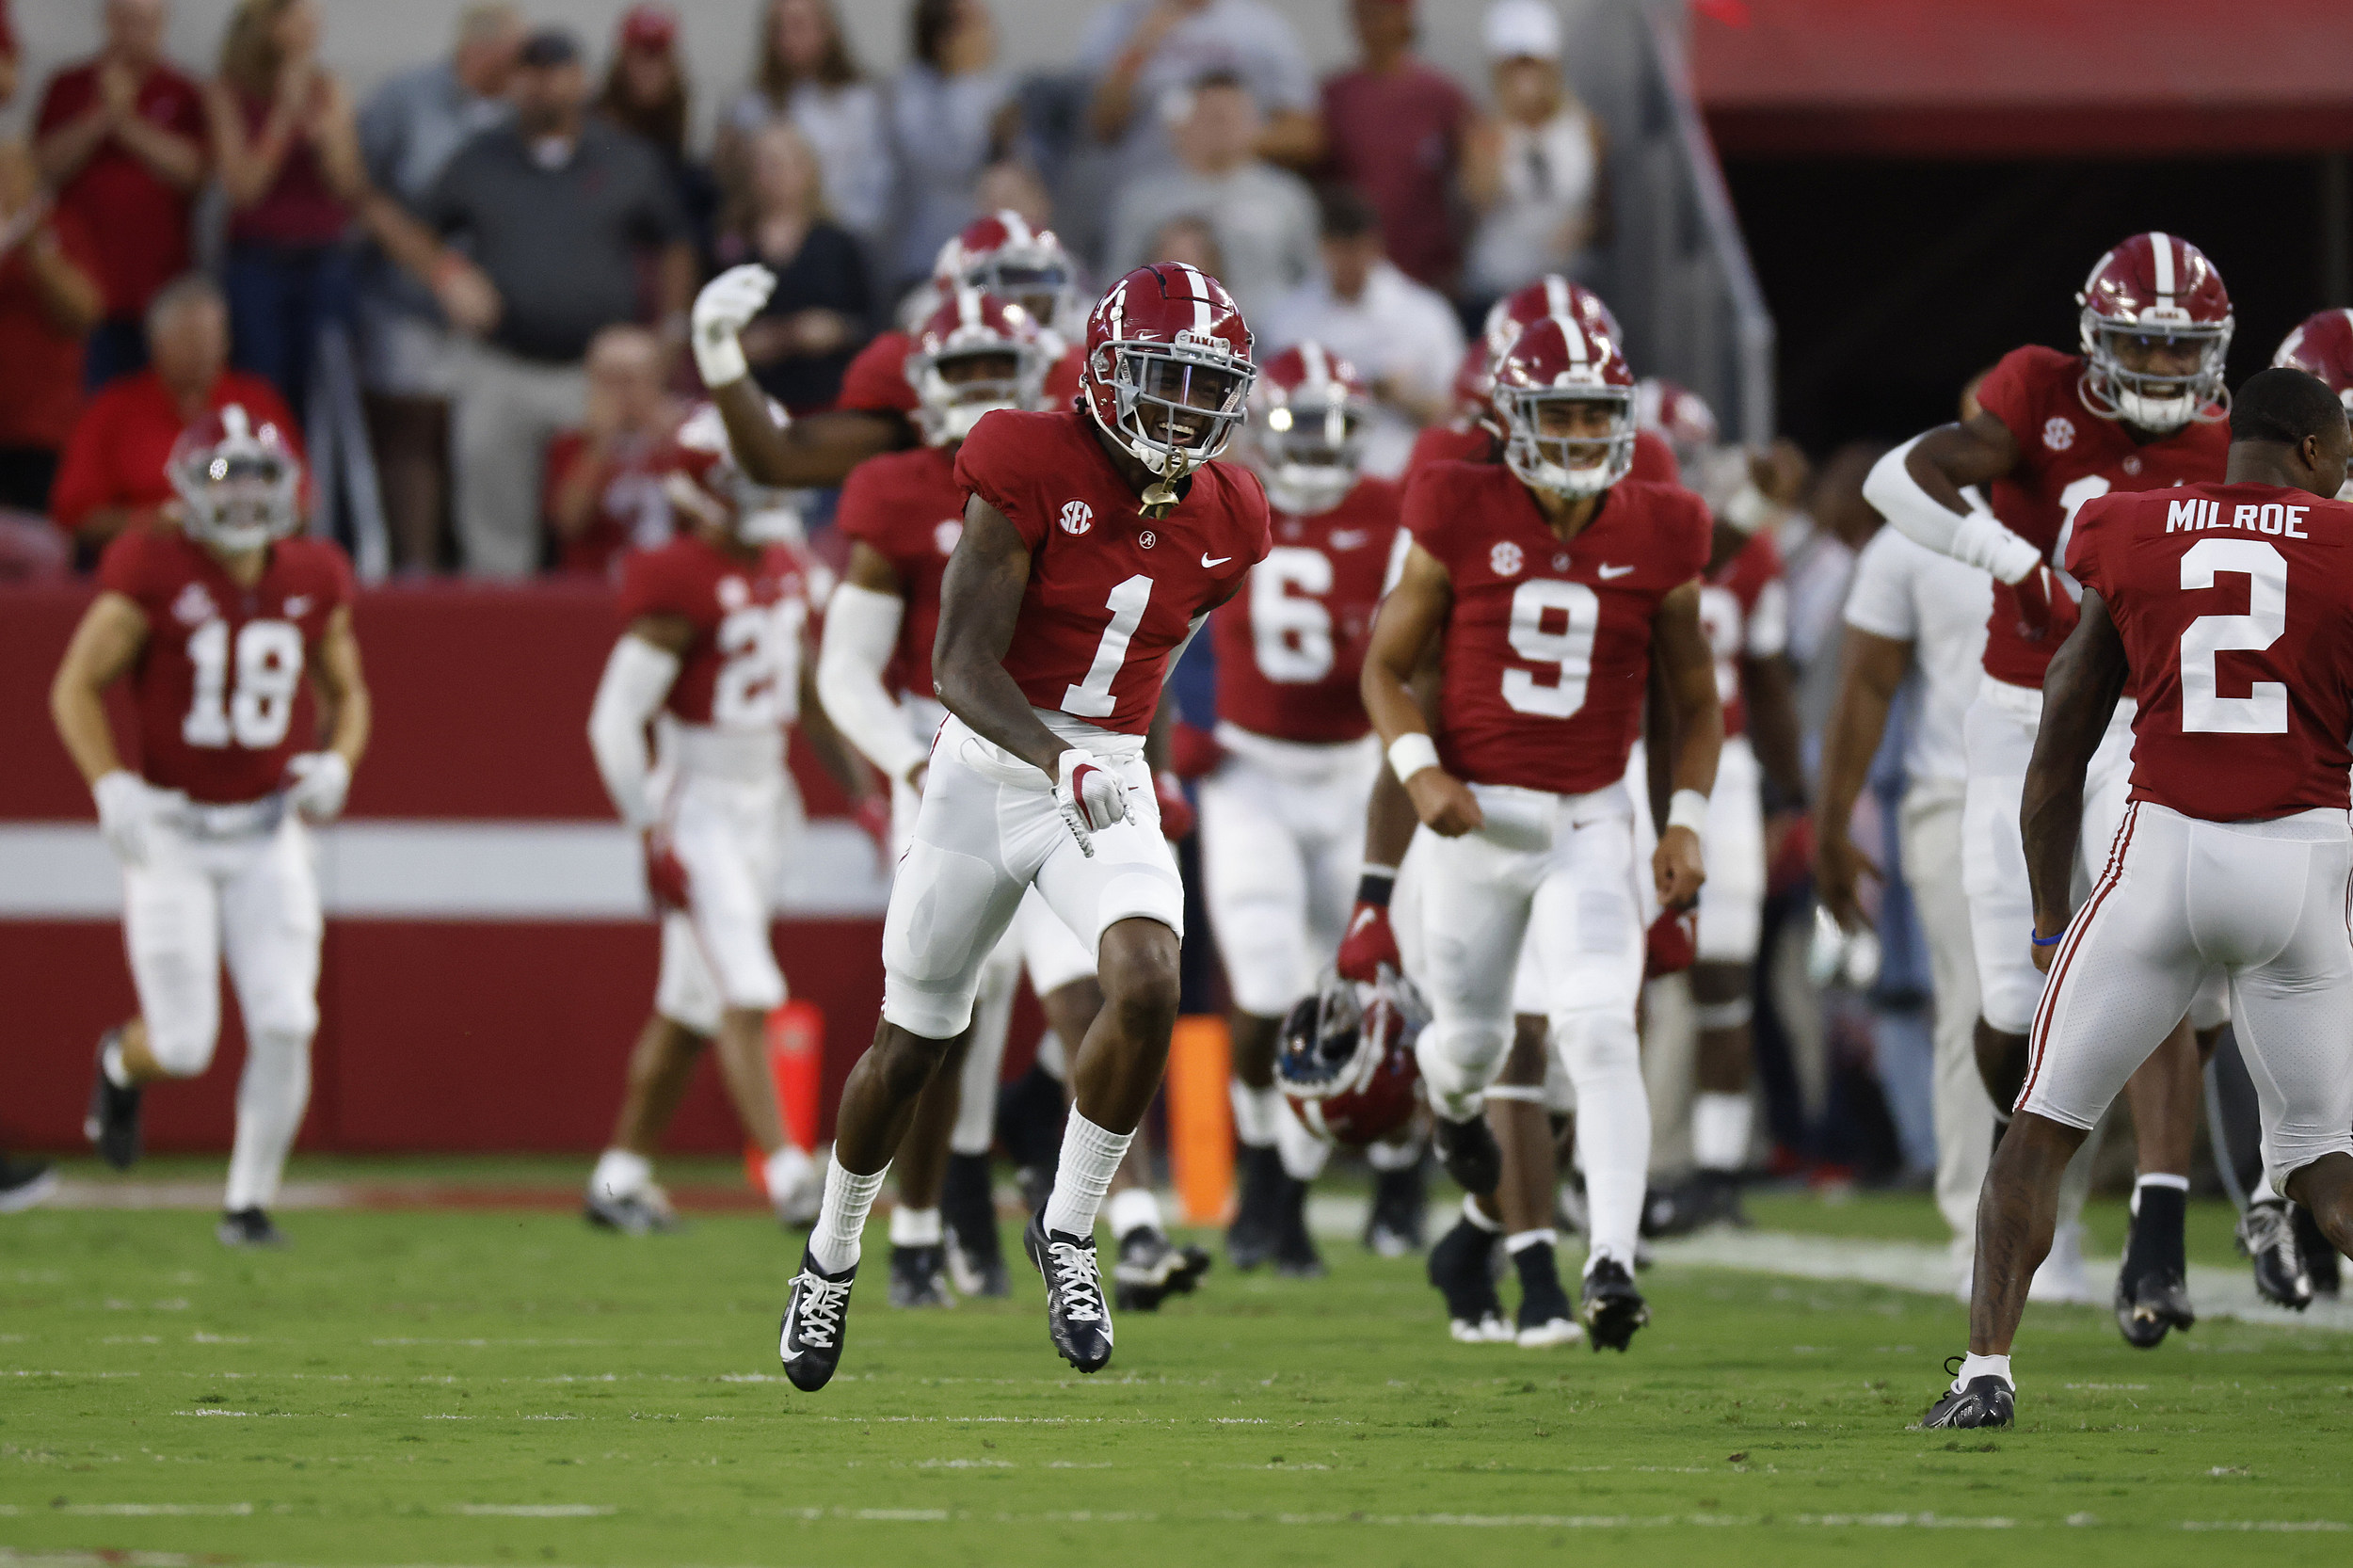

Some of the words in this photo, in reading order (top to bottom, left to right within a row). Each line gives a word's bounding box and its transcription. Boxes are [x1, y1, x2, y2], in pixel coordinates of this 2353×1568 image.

[1059, 501, 1093, 535] SEC
[2166, 498, 2311, 539] MILROE
[182, 617, 304, 747] 18
[1060, 573, 1154, 717] 1
[1249, 546, 1335, 682] 6
[1501, 577, 1599, 719] 9
[2180, 537, 2288, 734] 2
